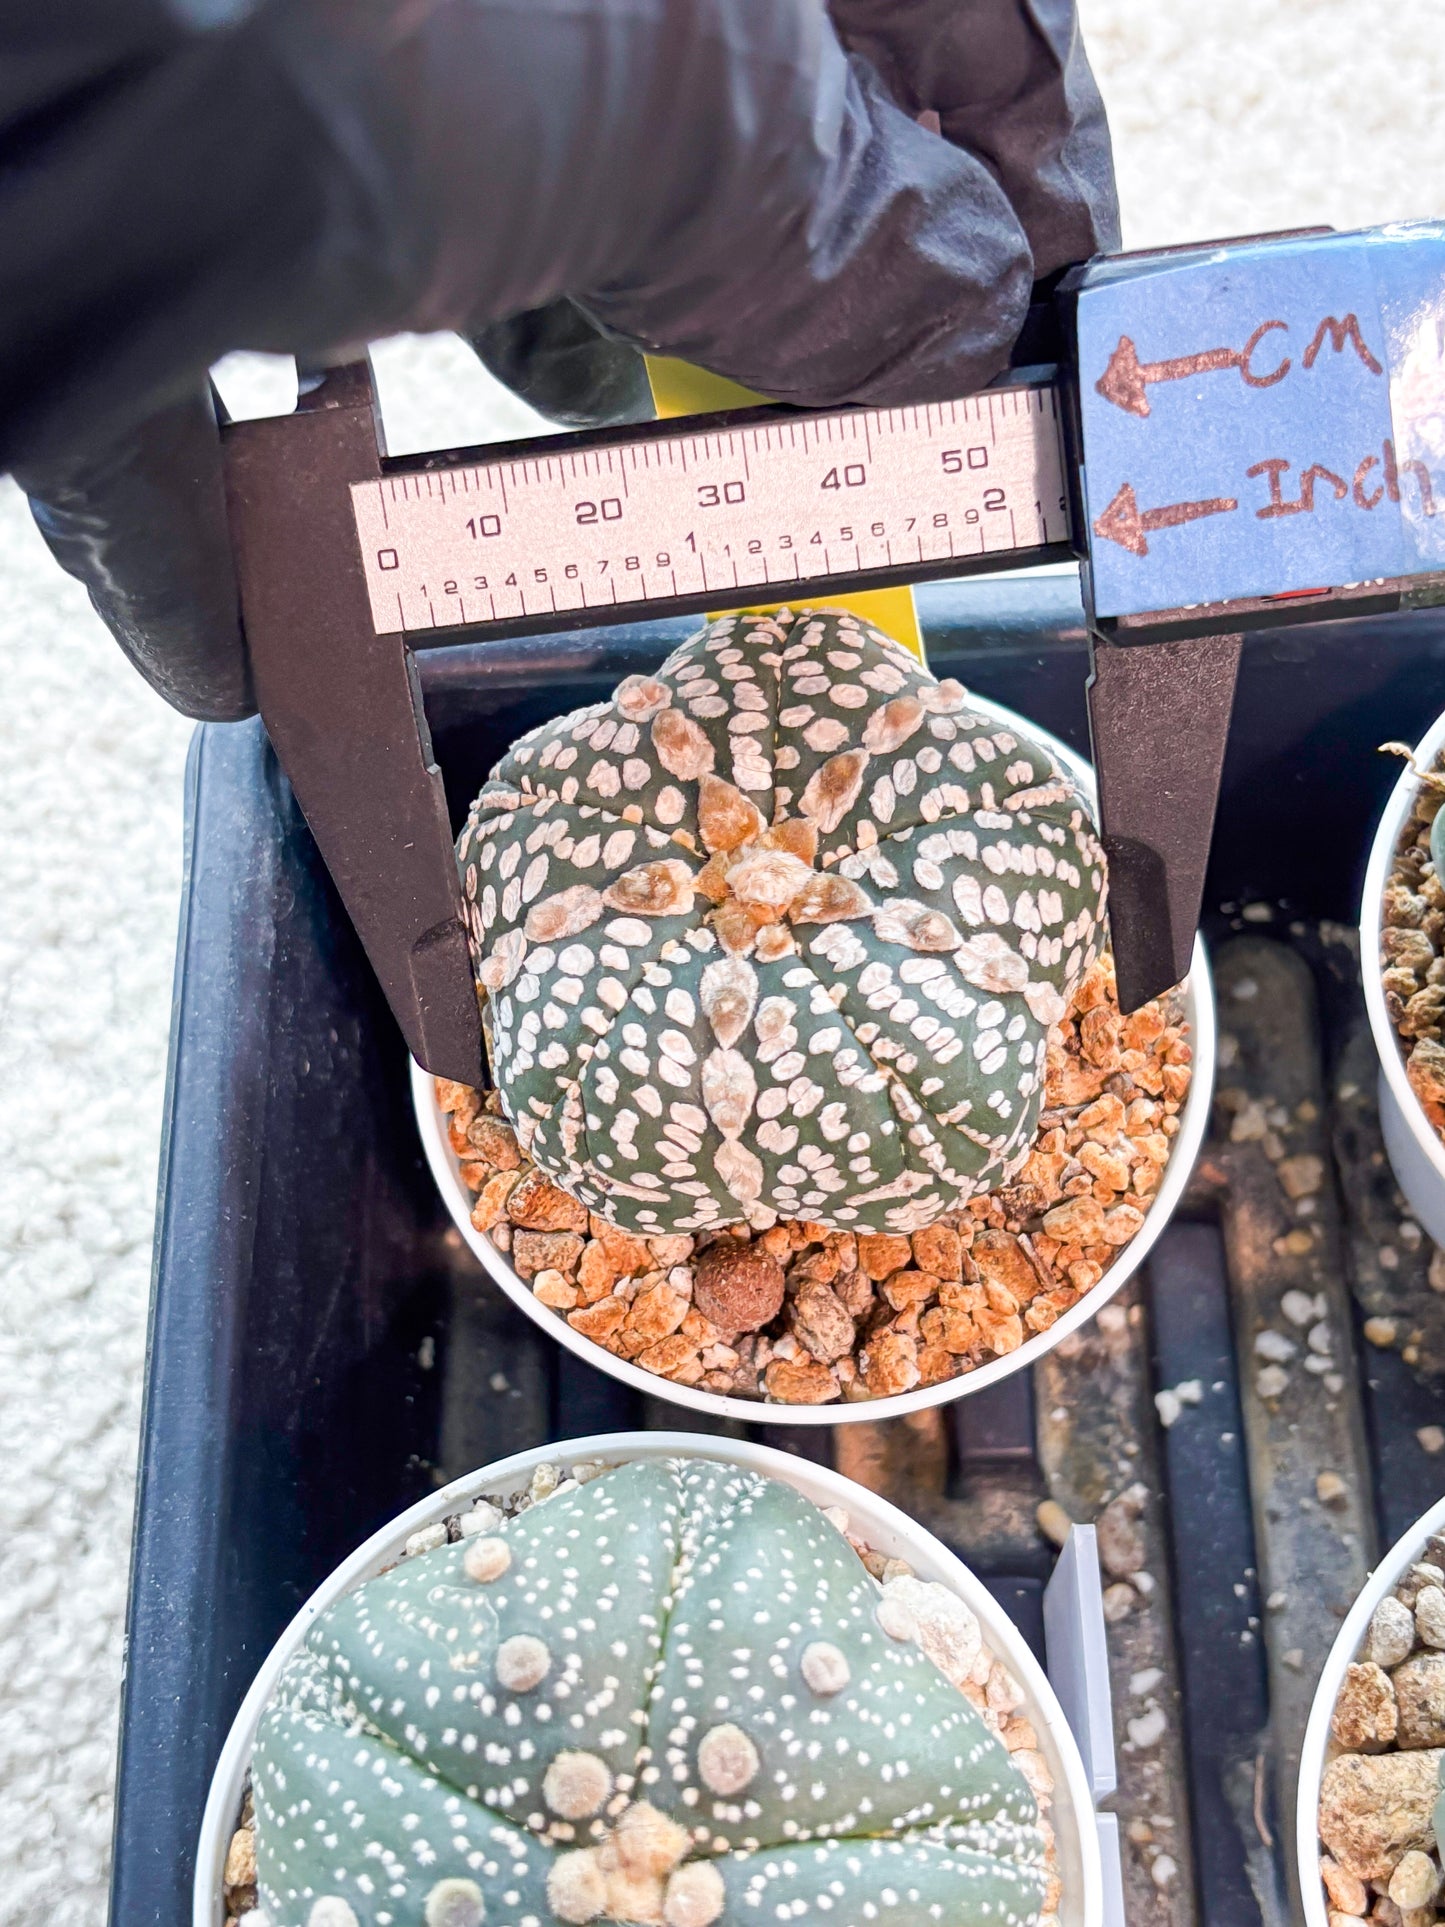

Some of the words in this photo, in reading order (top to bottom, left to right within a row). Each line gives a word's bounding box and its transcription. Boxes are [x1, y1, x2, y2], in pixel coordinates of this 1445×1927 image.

[1239, 312, 1384, 389] CM
[465, 514, 501, 540] 10
[574, 497, 623, 525] 20
[697, 480, 746, 508] 30
[820, 463, 867, 491] 40
[941, 446, 989, 474] 50
[1245, 438, 1436, 520] Inch
[377, 548, 399, 571] 0
[419, 584, 428, 598] 1
[443, 580, 459, 595] 2
[474, 576, 489, 590] 3
[504, 572, 518, 587] 4
[534, 568, 549, 583] 5
[564, 564, 579, 579] 6
[597, 560, 609, 575] 7
[625, 556, 641, 571] 8
[656, 552, 671, 567] 9
[684, 531, 697, 553] 1
[723, 544, 731, 558] 1
[747, 539, 763, 554] 2
[779, 535, 794, 550] 3
[809, 531, 823, 546] 4
[839, 526, 854, 541] 5
[871, 522, 885, 537] 6
[905, 518, 917, 533] 7
[932, 513, 949, 528] 8
[964, 508, 980, 524] 9
[983, 488, 1008, 512] 2
[1034, 500, 1042, 515] 1
